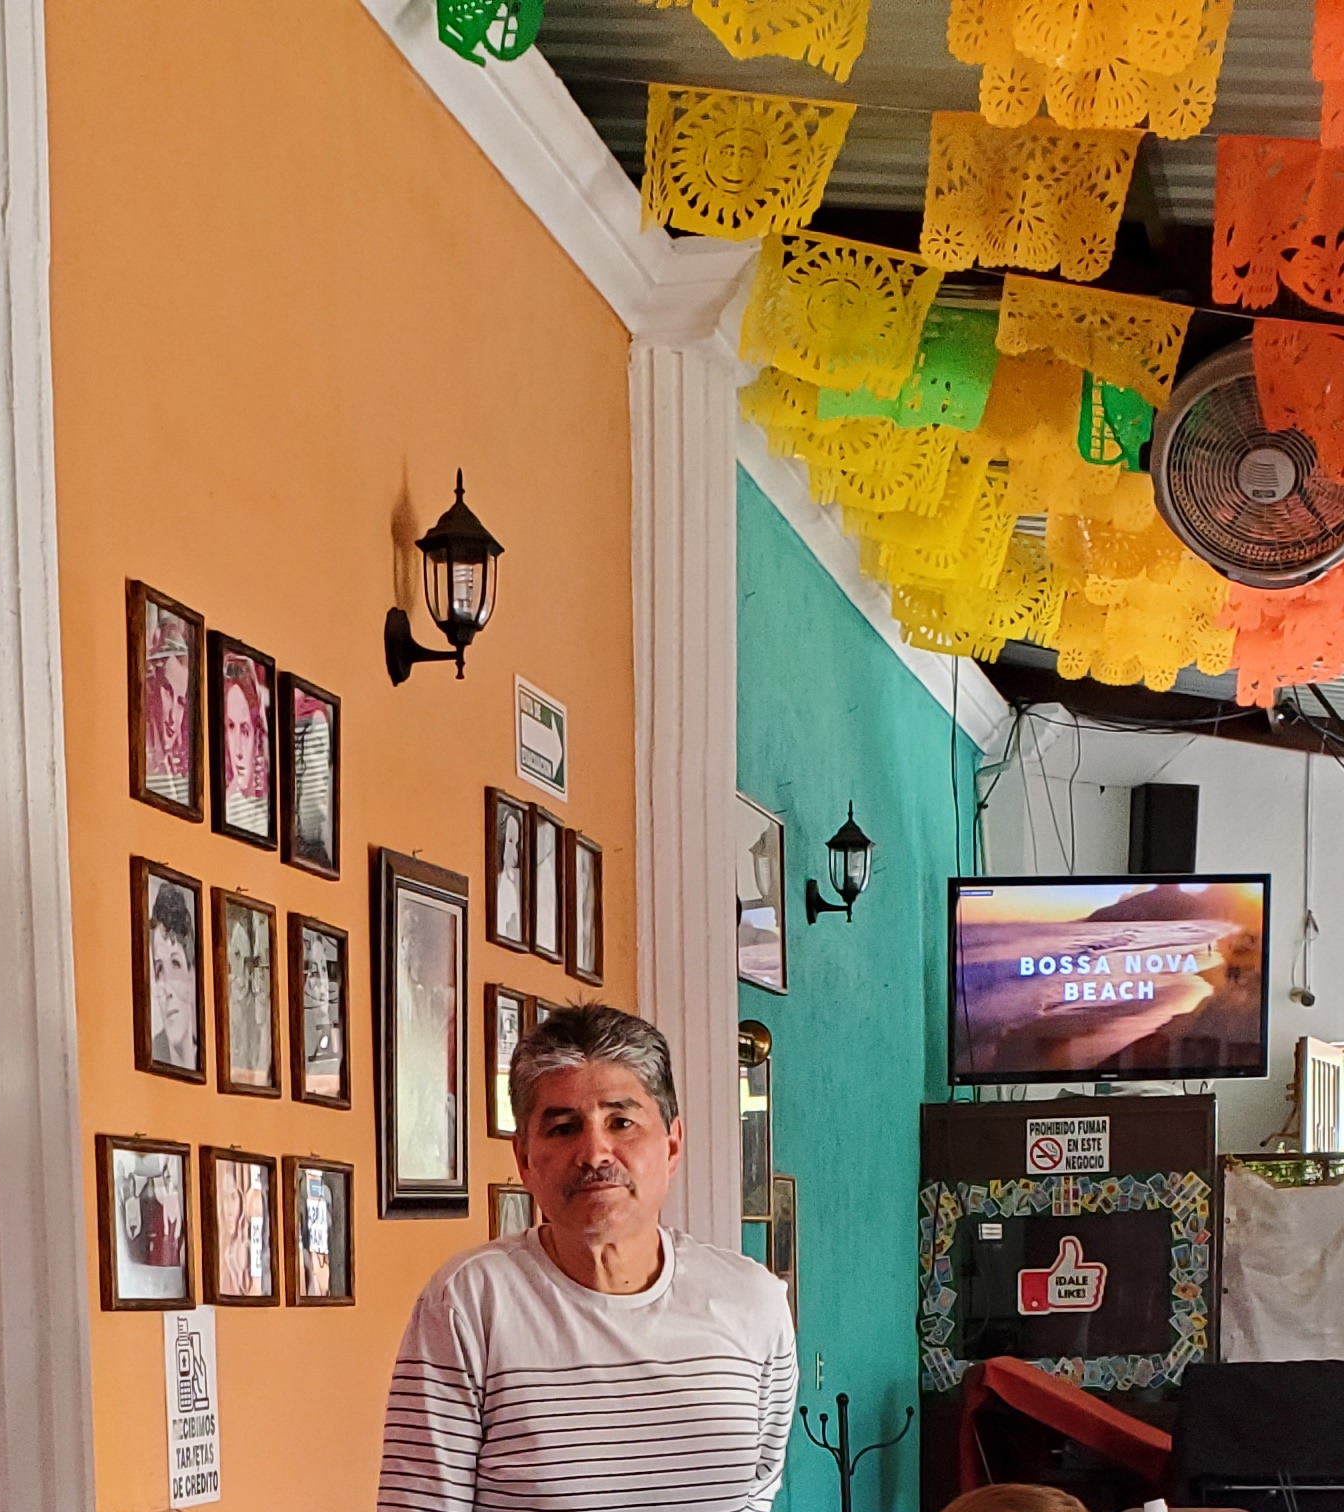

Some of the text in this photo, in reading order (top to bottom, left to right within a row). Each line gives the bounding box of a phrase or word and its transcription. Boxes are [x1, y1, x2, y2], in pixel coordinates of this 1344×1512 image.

[1020, 954, 1199, 976] BOSSA NOVA
[1064, 980, 1154, 1001] BEACH
[1029, 1120, 1107, 1136] PROHIBIDO FUMAR
[1067, 1137, 1102, 1152] EN ESTE
[1065, 1155, 1104, 1170] NEGOCIO
[1058, 1288, 1086, 1299] LIKE!
[176, 1442, 214, 1470] TARJETAS
[173, 1476, 184, 1499] DE
